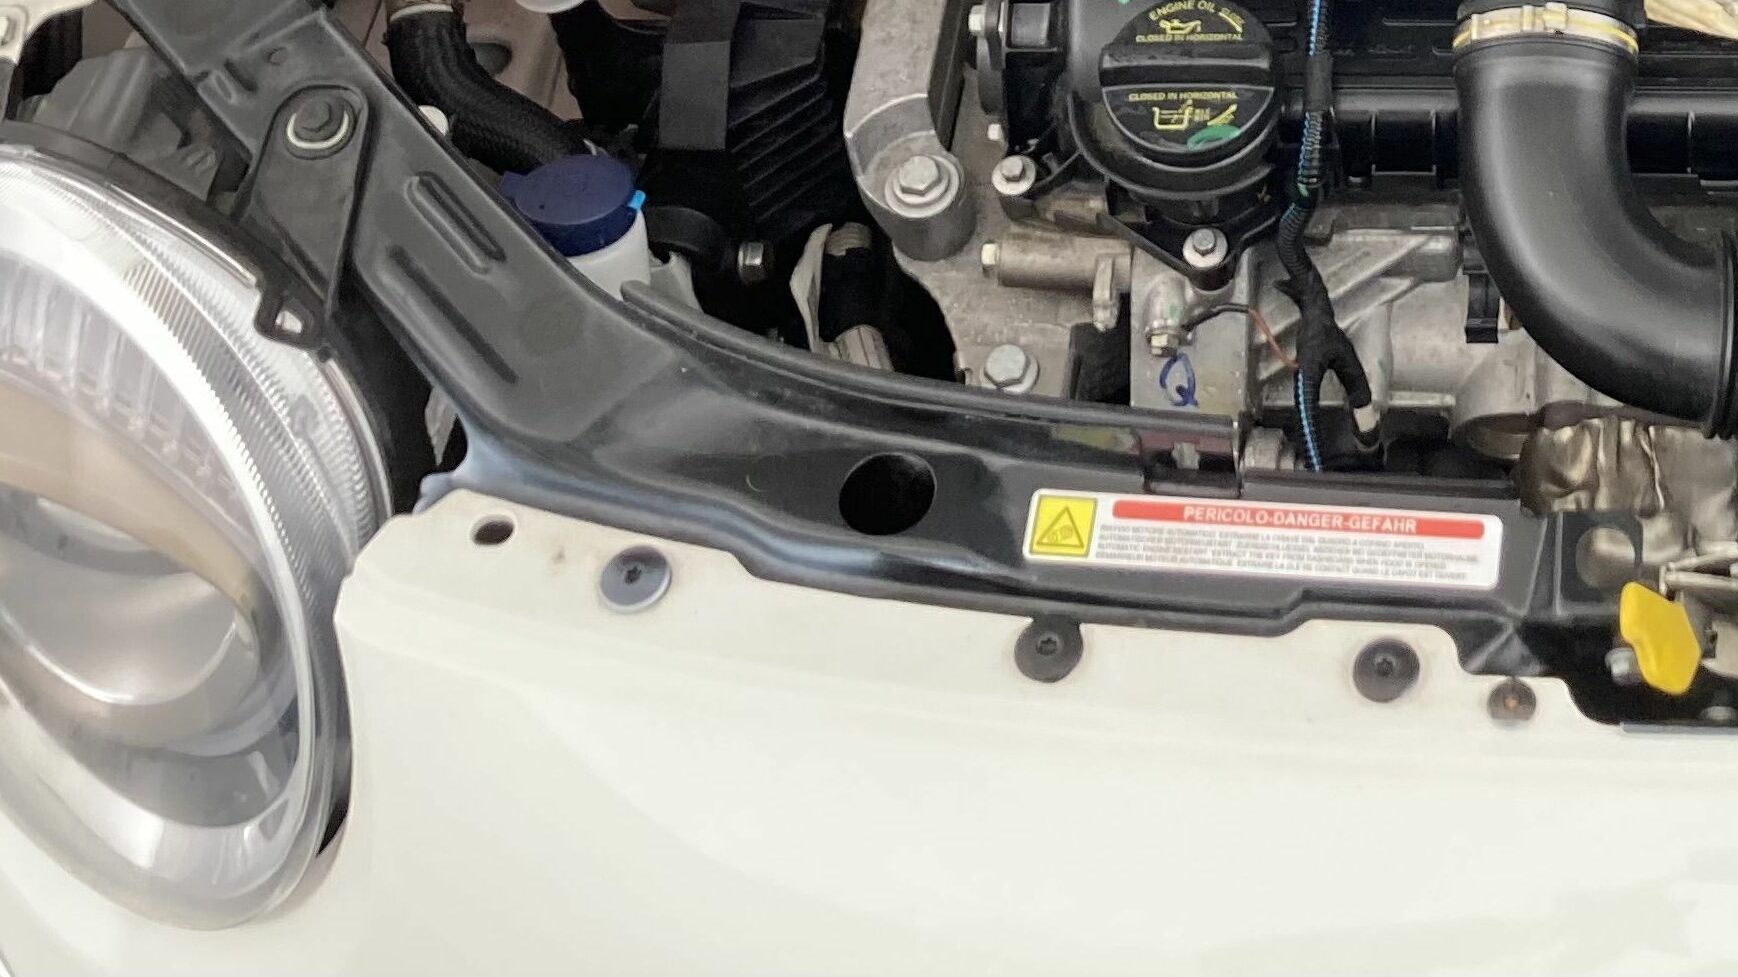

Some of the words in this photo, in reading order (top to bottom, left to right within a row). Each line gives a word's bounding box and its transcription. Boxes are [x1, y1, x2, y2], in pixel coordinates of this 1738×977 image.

[1148, 0, 1195, 21] ENGINE
[1197, 0, 1215, 13] OIL
[1135, 33, 1172, 43] CLOSED
[1174, 33, 1185, 41] IN
[1186, 32, 1244, 41] HORIZONTAL
[1128, 92, 1166, 102] CLOSED
[1167, 92, 1178, 100] IN
[1179, 91, 1239, 100] HORIZONTAL
